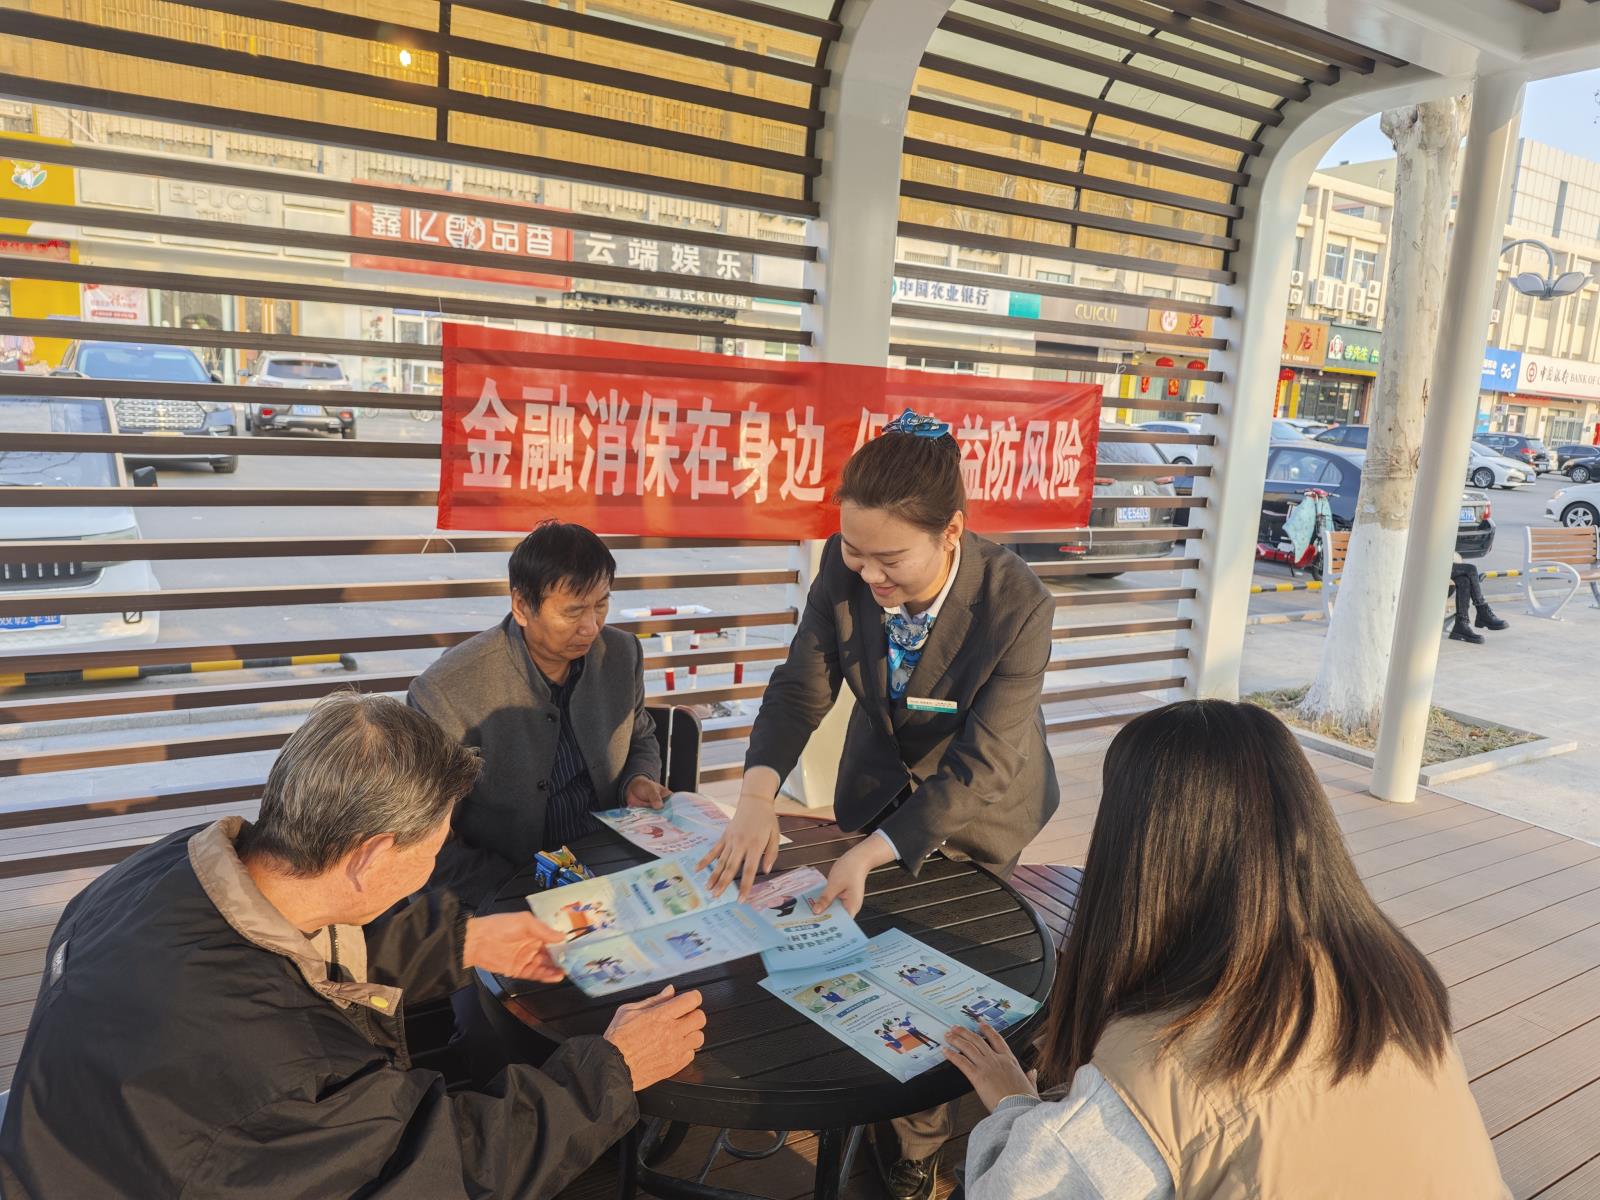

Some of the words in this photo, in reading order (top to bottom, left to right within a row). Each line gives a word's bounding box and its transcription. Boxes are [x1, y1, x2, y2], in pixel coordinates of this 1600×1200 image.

[585, 233, 741, 280] 云端娱乐
[899, 278, 990, 306] 中国农业银行
[1075, 303, 1118, 323] CUICUI
[1500, 363, 1513, 380] 5G
[1540, 366, 1568, 385] 中国银行
[1570, 373, 1587, 385] BANK
[461, 377, 825, 504] 金融消保在身边
[852, 407, 1085, 501] 益防风险
